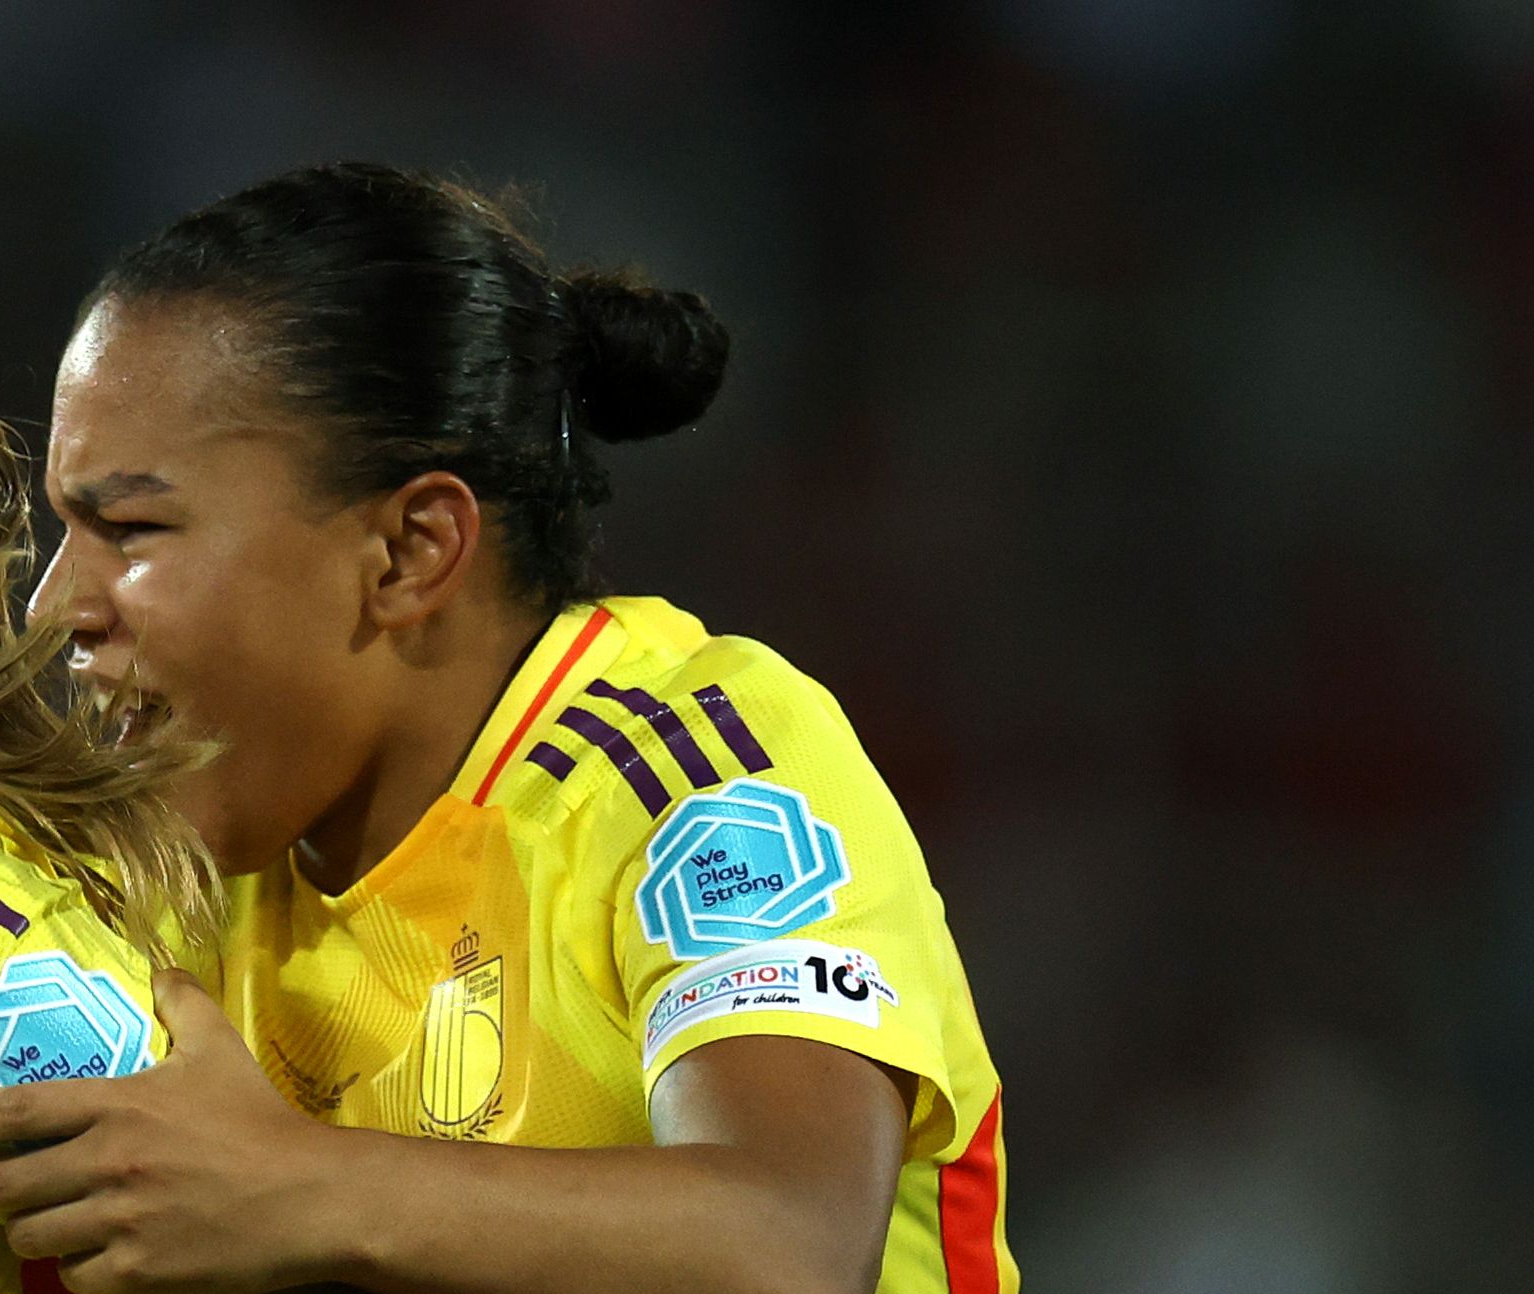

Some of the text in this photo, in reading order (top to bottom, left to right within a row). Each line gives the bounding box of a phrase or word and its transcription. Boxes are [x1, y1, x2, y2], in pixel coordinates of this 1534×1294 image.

[690, 848, 727, 869] We
[701, 873, 784, 908] Strong
[732, 995, 750, 1011] for
[753, 993, 801, 1004] children
[2, 1045, 41, 1070] We
